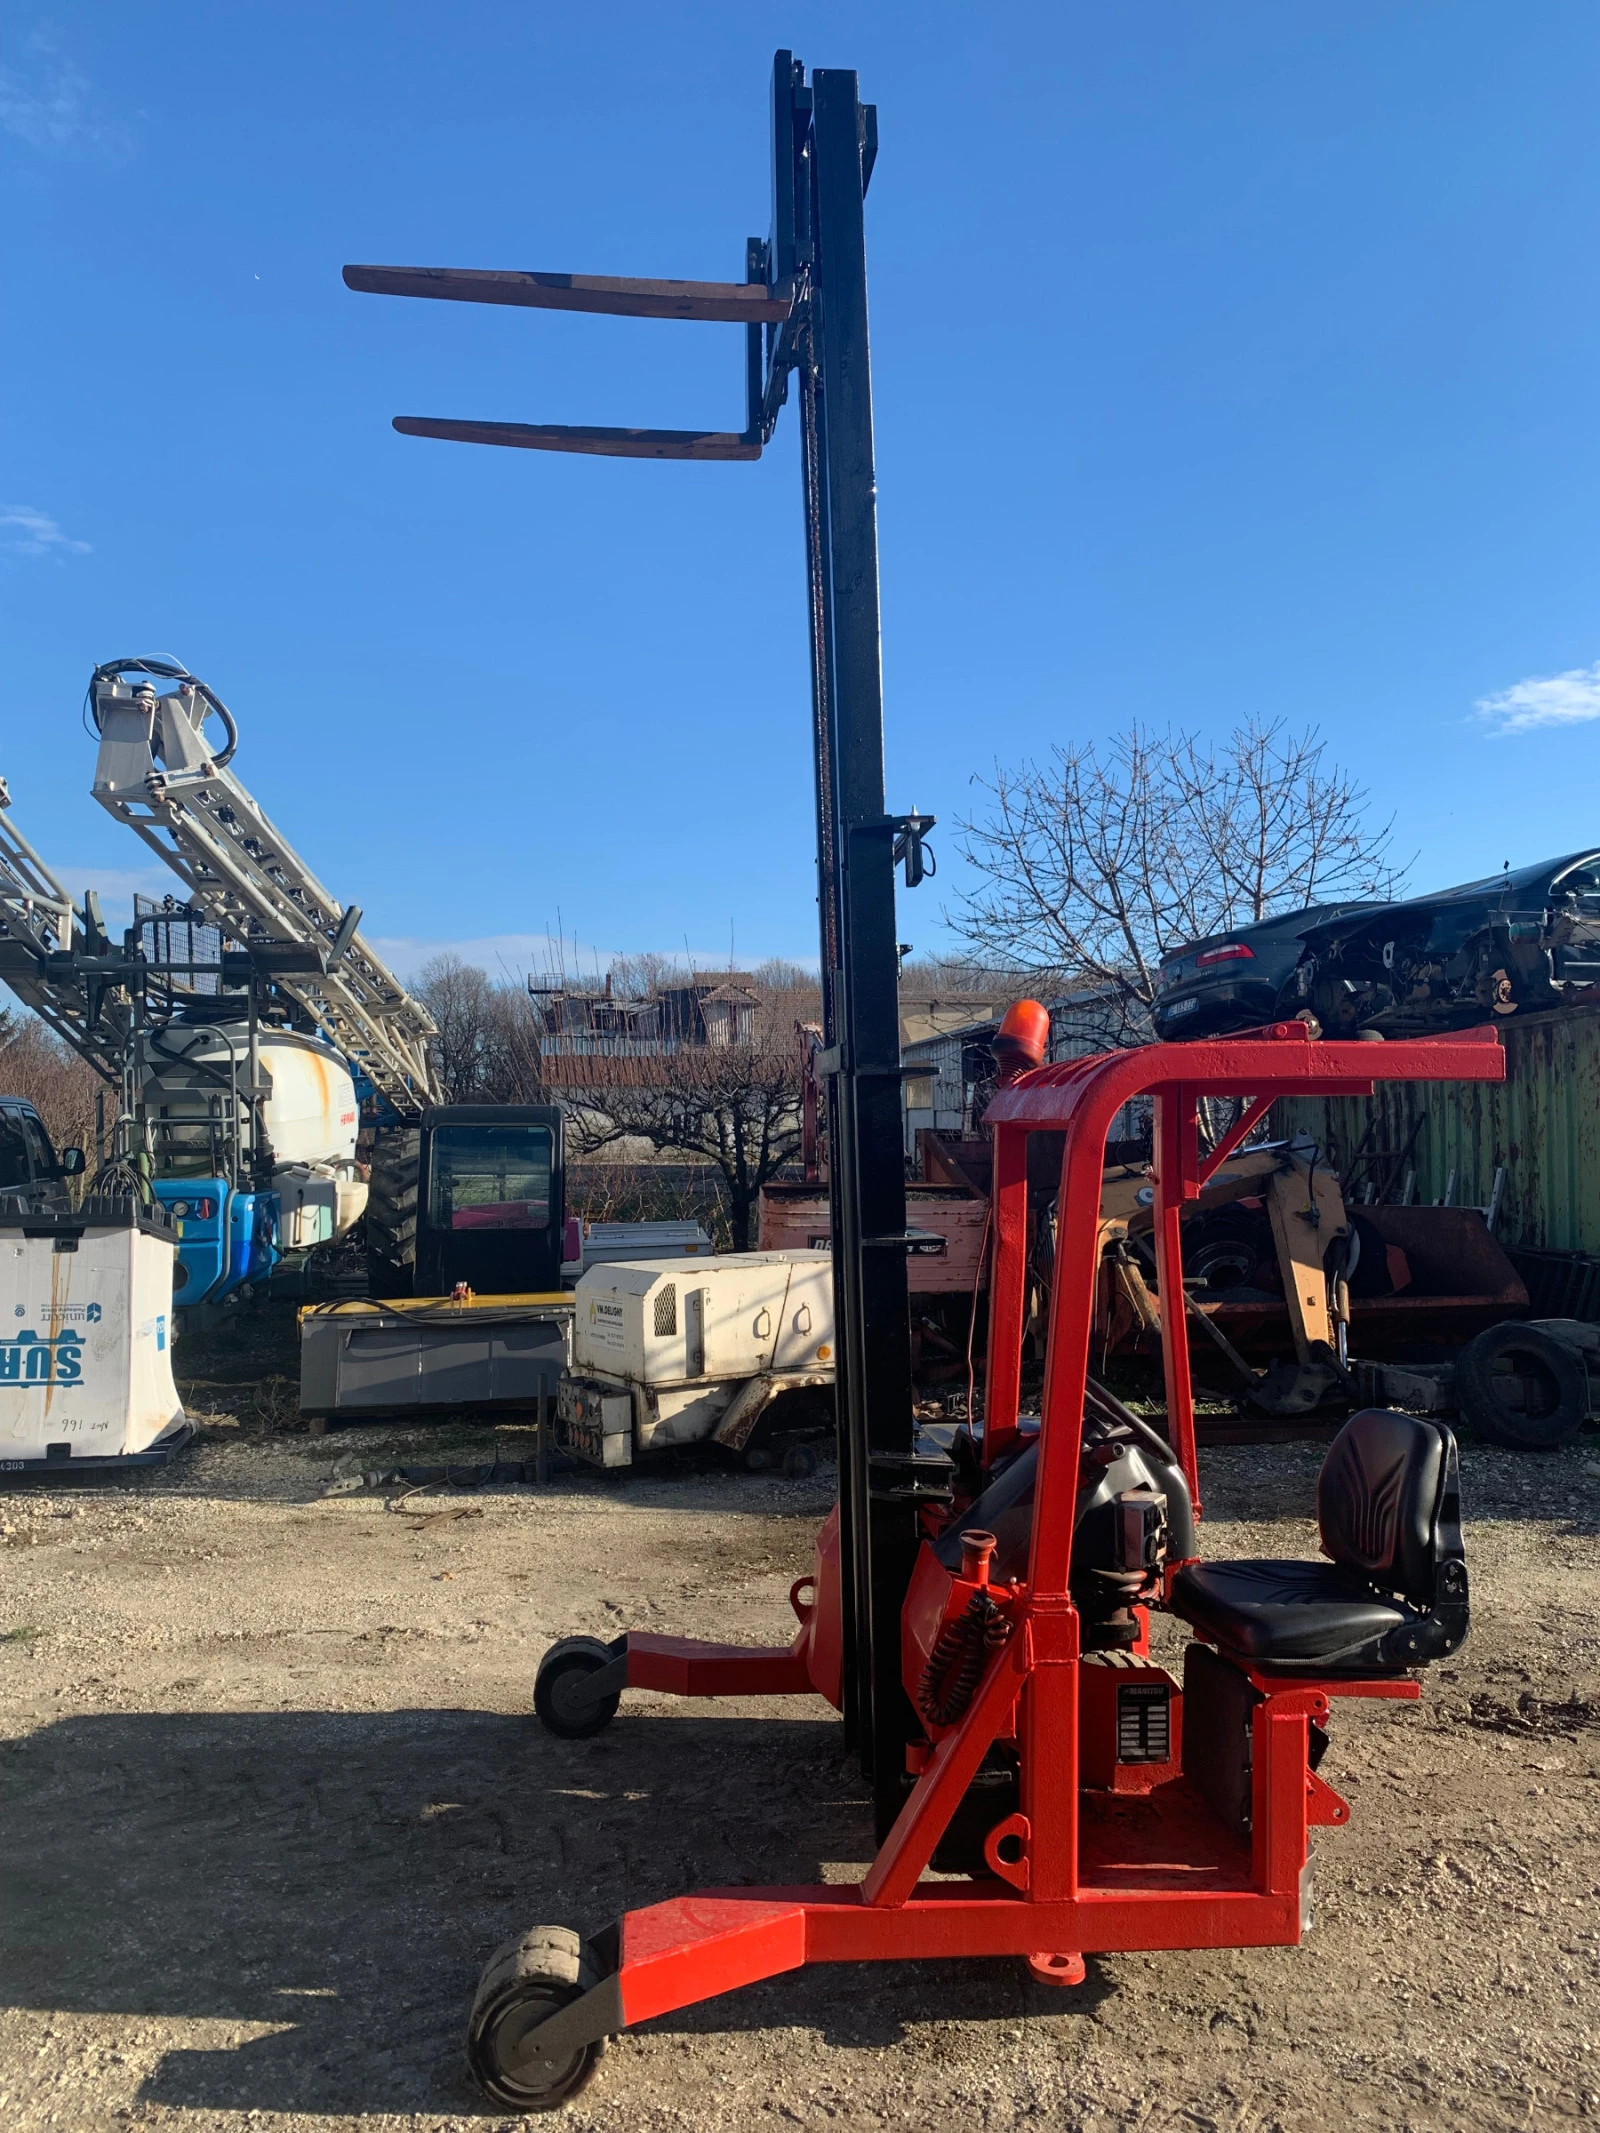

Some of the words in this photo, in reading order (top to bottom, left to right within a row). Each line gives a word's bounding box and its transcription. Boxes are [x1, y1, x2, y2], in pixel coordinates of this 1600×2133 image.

[41, 1312, 86, 1324] unicorr
[61, 1418, 83, 1433] 166
[1129, 1687, 1164, 1695] MANITOU
